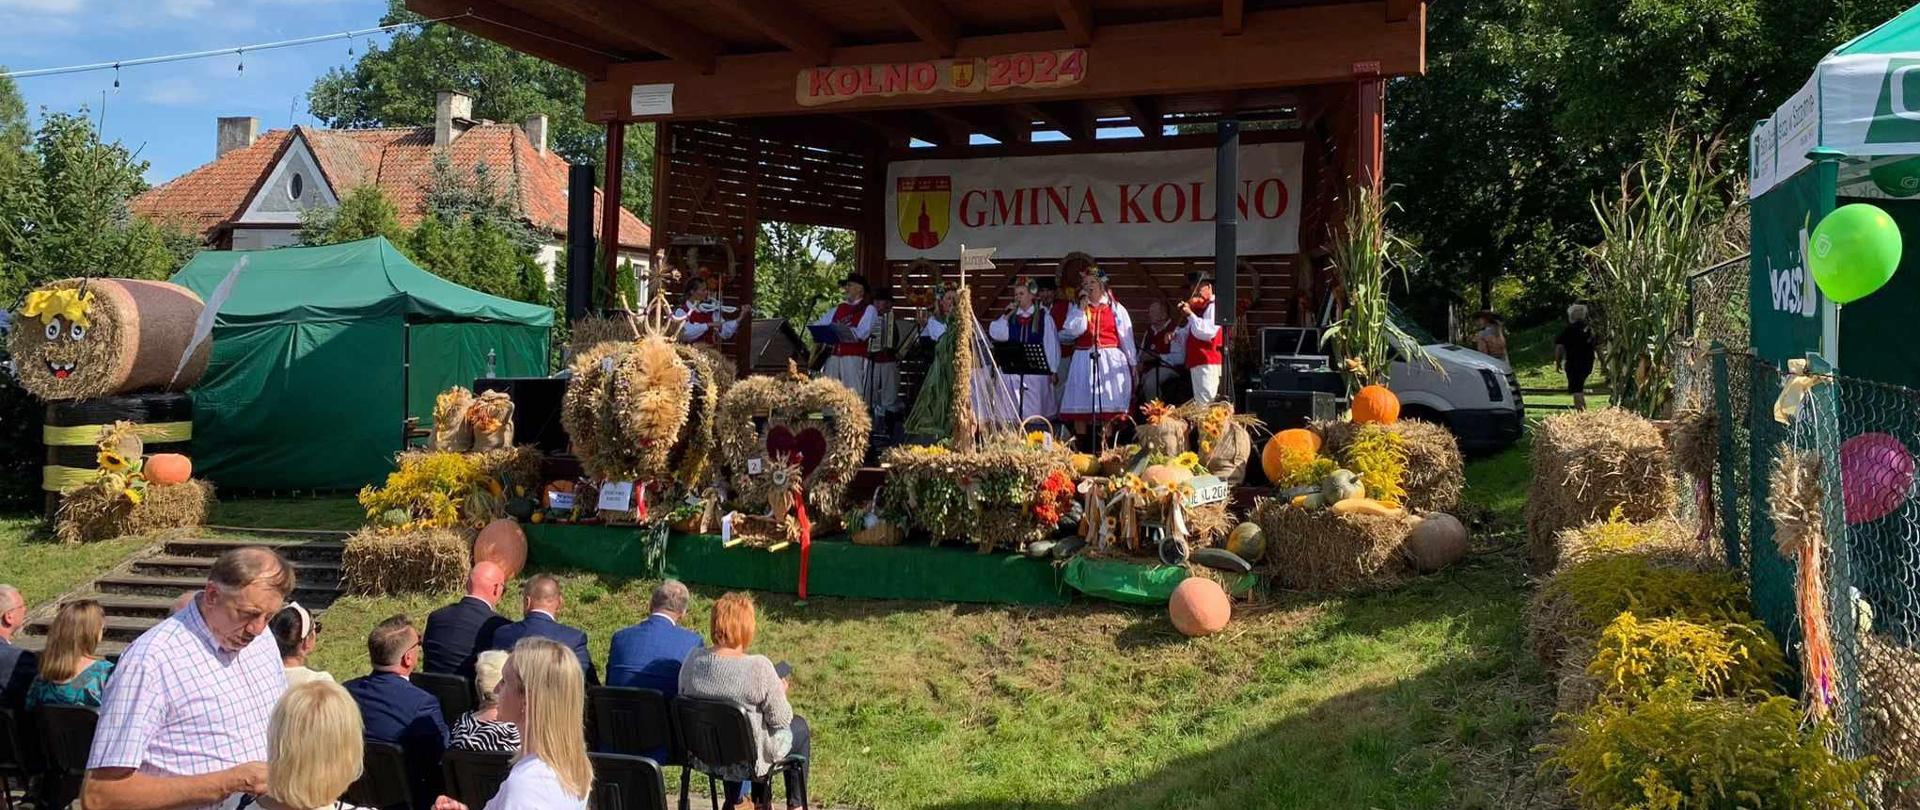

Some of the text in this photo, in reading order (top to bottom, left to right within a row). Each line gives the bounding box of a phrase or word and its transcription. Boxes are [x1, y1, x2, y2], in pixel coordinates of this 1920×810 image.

[809, 50, 1083, 97] KOLNO 2024
[958, 177, 1289, 228] GMINA KOLNO
